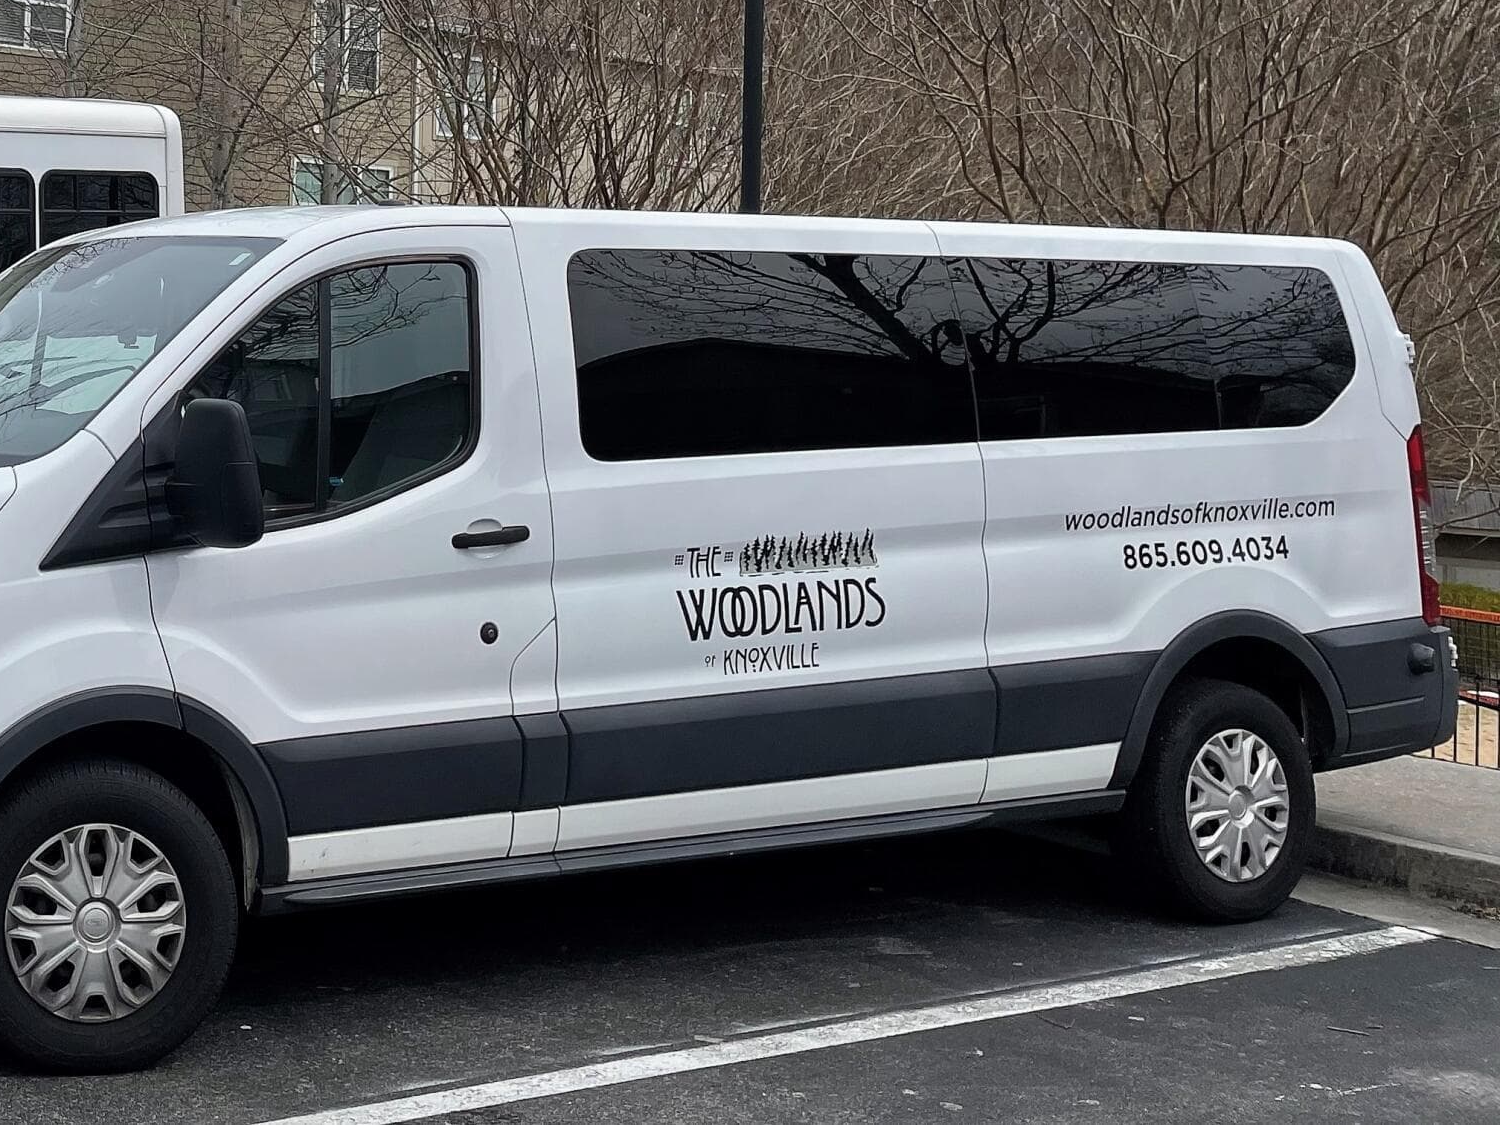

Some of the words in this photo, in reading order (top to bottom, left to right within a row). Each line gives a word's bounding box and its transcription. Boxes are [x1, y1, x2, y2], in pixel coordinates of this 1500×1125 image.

[1064, 498, 1335, 531] woodlandsofknoxville.com
[686, 546, 722, 578] THE
[1123, 535, 1289, 569] 865.609.4034
[676, 577, 886, 641] WOODLANDS
[724, 642, 820, 675] KNOXVILLE
